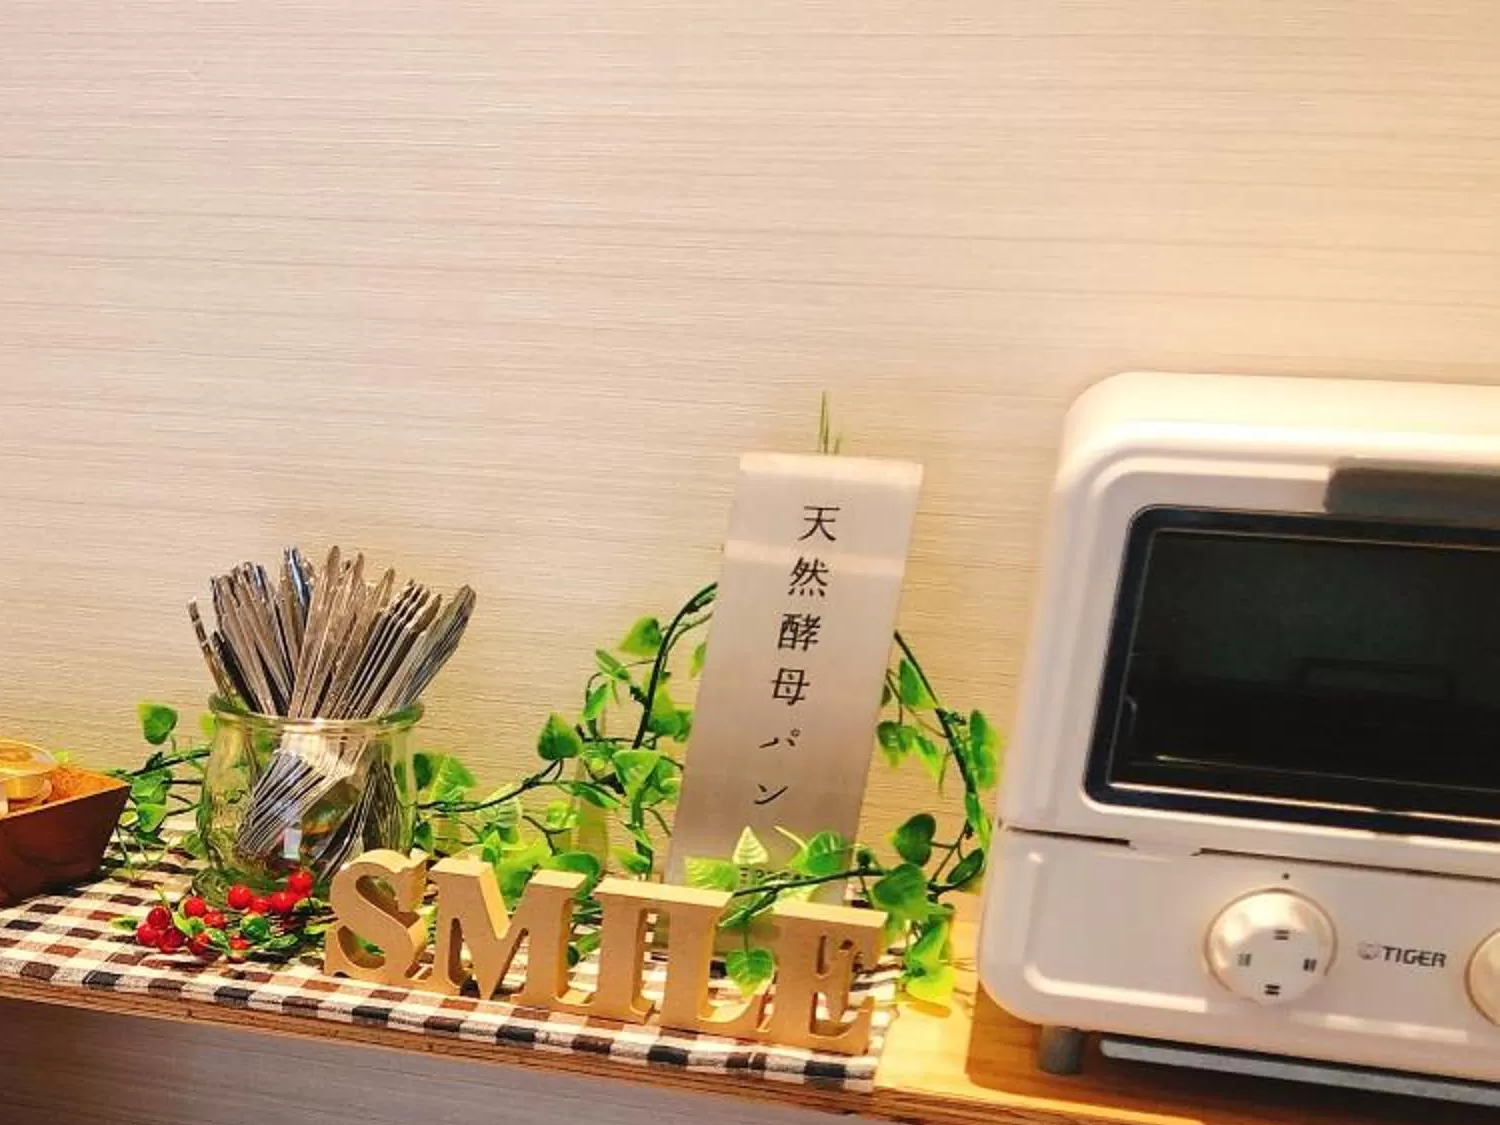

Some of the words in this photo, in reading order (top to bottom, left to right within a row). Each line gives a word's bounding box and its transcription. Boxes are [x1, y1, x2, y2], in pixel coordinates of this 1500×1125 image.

[754, 505, 841, 805] 天然酵母パン
[324, 849, 889, 1054] SMILE
[1382, 945, 1447, 968] TIGER
